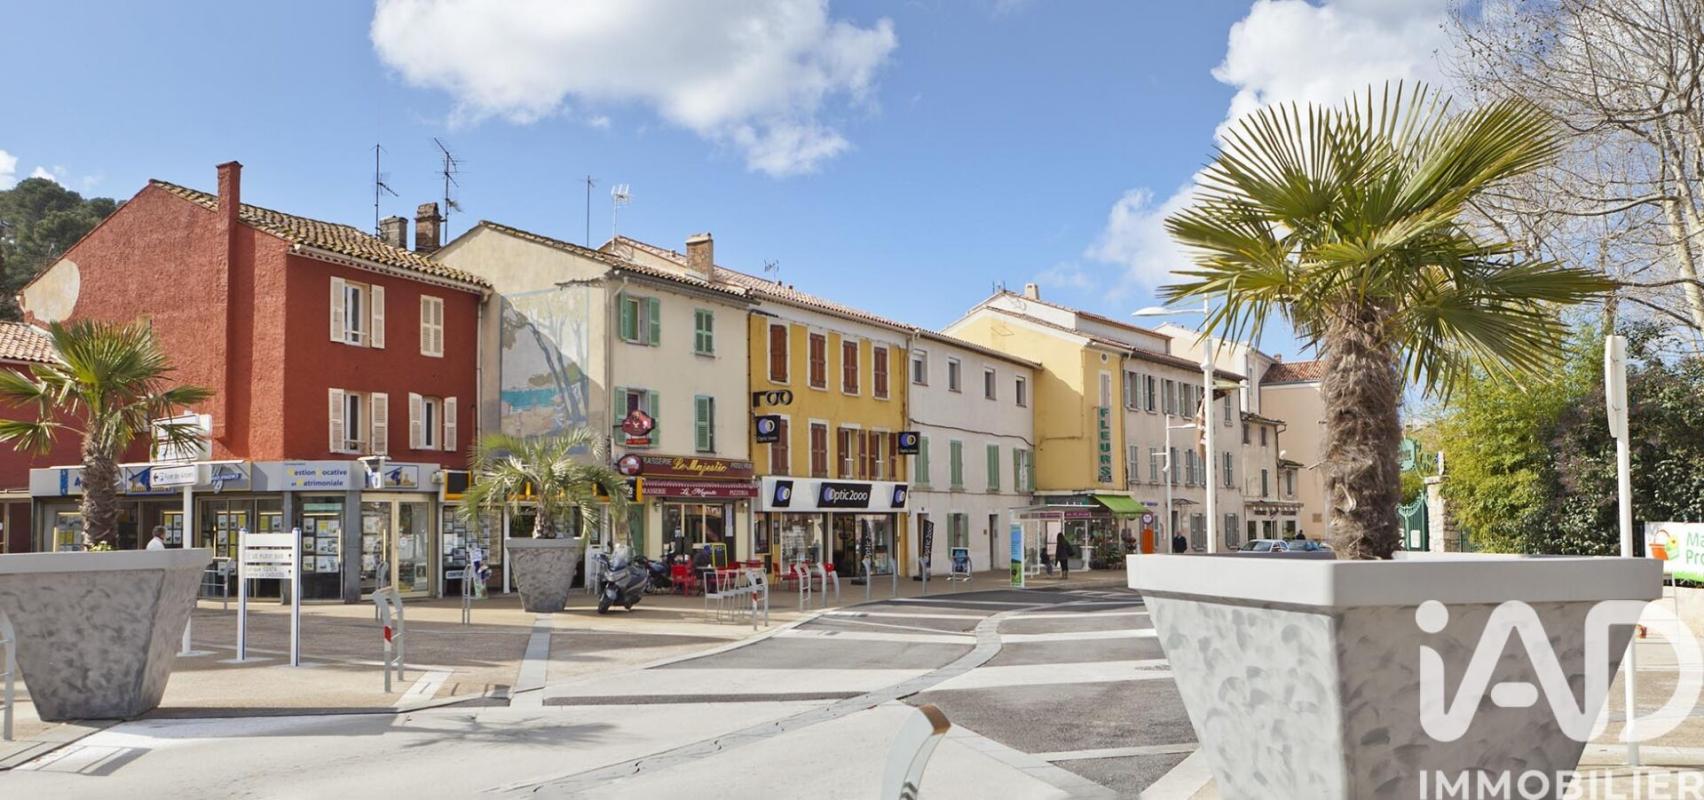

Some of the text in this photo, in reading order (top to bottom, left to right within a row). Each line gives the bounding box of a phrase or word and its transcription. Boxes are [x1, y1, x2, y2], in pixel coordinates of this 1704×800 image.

[1100, 408, 1111, 476] FLEURS
[829, 488, 868, 504] Optic 2000
